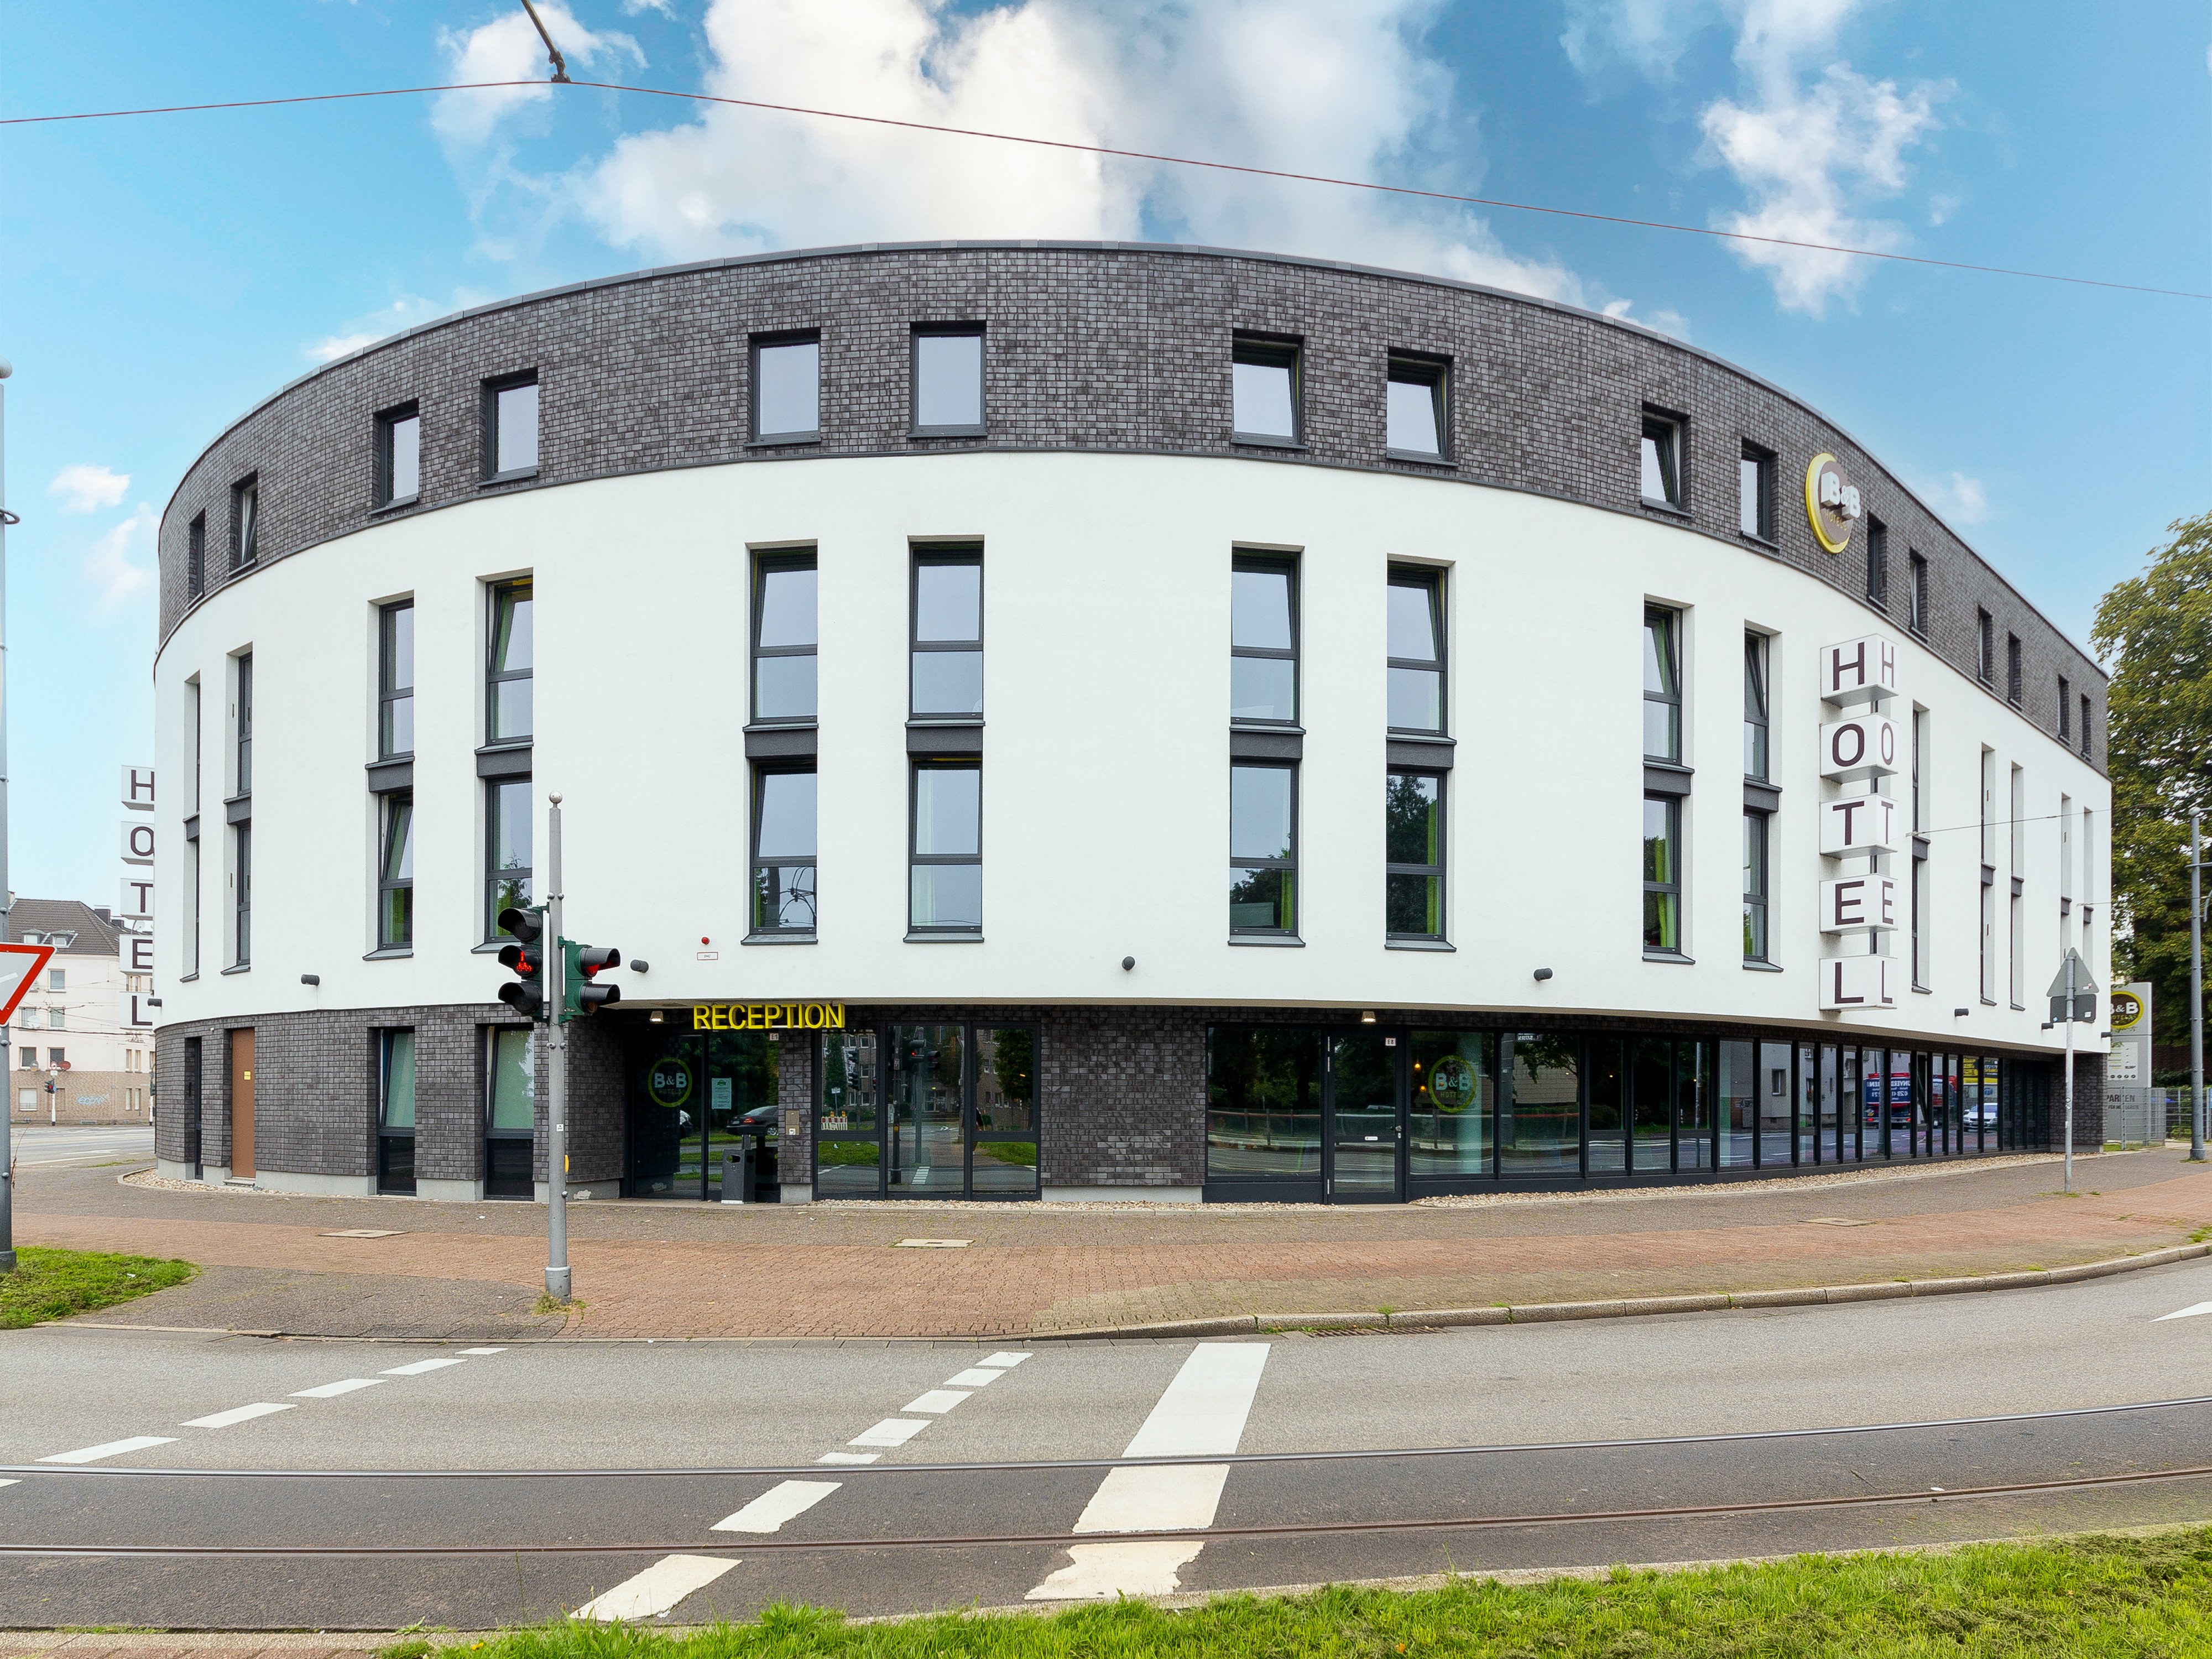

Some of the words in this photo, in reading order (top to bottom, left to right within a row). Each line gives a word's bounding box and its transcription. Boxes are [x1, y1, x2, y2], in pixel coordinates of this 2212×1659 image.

[1821, 471, 1861, 518] B&B
[1825, 511, 1848, 531] HOTELS
[1832, 641, 1865, 1004] HOTEL
[1881, 645, 1894, 1004] HOTEL
[131, 769, 154, 1026] HOTEL
[693, 1003, 845, 1029] RECEPTION
[655, 1073, 687, 1088] B&B
[1436, 1073, 1470, 1090] B&B
